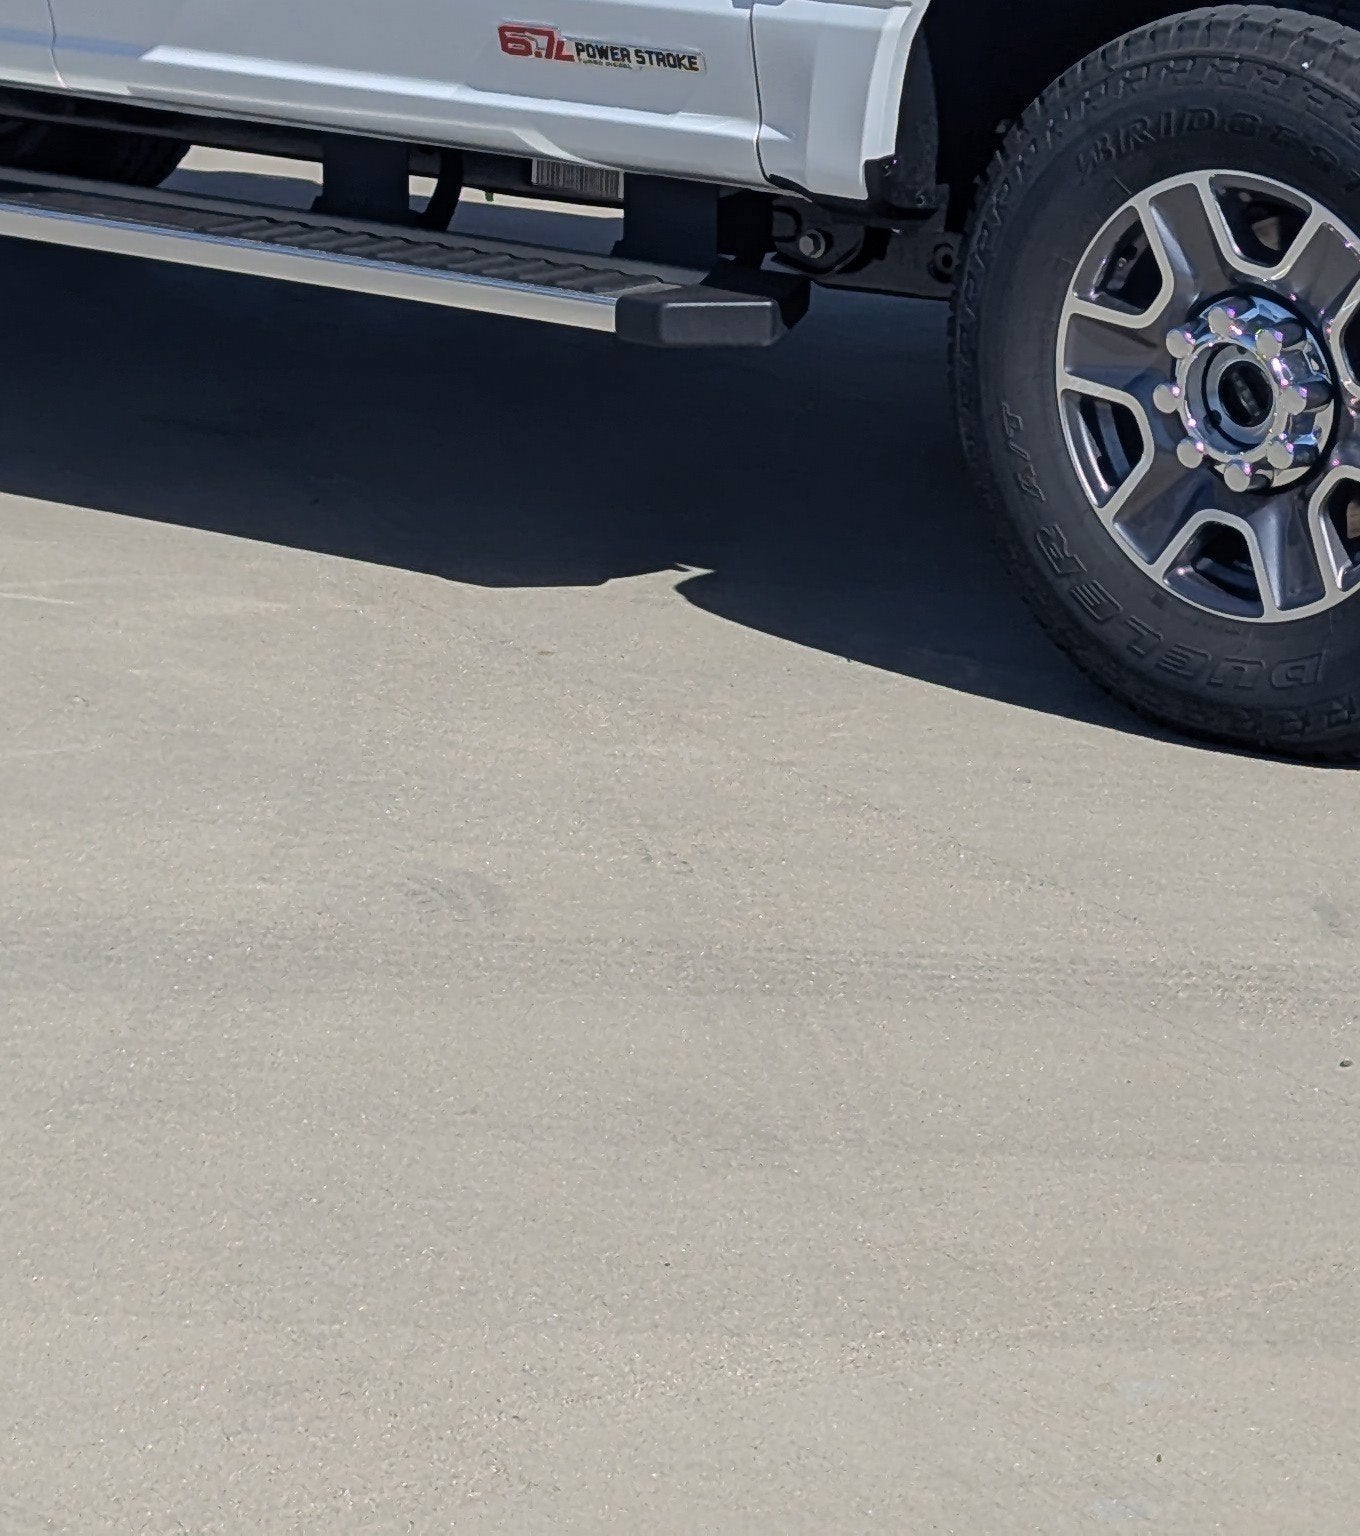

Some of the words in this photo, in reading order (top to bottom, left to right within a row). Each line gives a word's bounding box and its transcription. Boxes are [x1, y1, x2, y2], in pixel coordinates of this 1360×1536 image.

[497, 24, 575, 62] 6.7L
[575, 41, 632, 63] POWER
[634, 48, 700, 72] STROKE
[1035, 523, 1328, 690] DUELER
